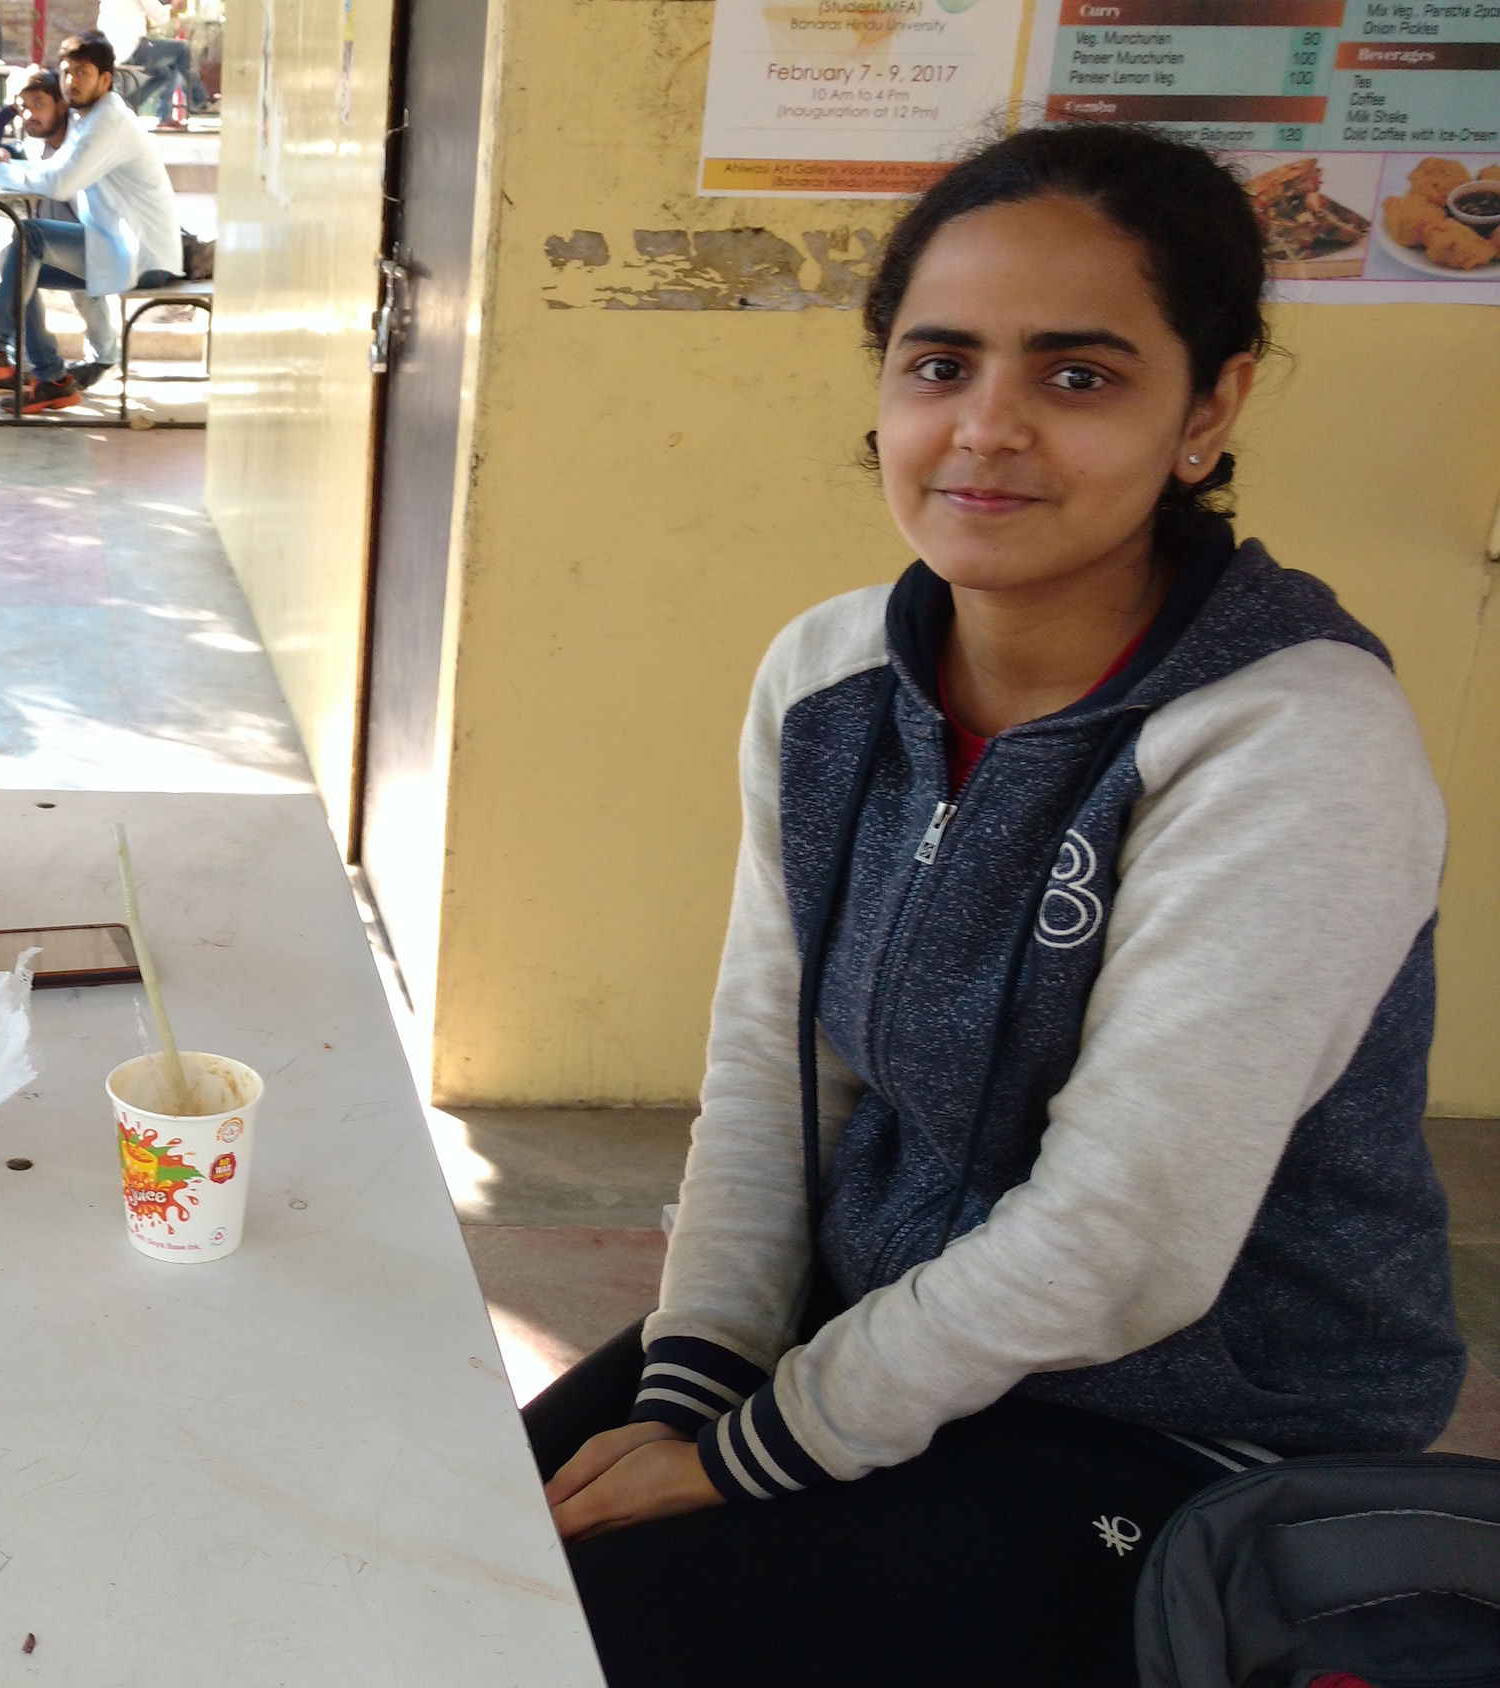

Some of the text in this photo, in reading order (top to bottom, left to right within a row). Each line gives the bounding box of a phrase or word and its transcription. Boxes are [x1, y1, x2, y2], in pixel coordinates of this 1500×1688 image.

[790, 18, 947, 34] Banaras Hindu University
[1363, 21, 1396, 35] Onion
[1073, 51, 1114, 65] Paneer
[1292, 52, 1318, 66] 100
[1357, 48, 1436, 64] Beverages
[767, 64, 853, 84] February
[859, 65, 871, 82] 7
[911, 65, 958, 83] 2017
[1069, 70, 1110, 85] Paneer
[1112, 70, 1150, 85] Lemon
[1289, 71, 1314, 85] 100
[1353, 75, 1372, 89] Tea
[811, 88, 910, 101] 10 Am to 4 Pm
[1349, 92, 1385, 106] Coffee
[777, 104, 872, 120] (Inauguration
[875, 105, 889, 118] at
[892, 105, 908, 119] 12
[1347, 110, 1408, 124] Milk Shake
[1279, 128, 1302, 142] 120
[1343, 127, 1368, 142] Cold
[1370, 127, 1406, 142] Coffee
[1409, 127, 1436, 142] with
